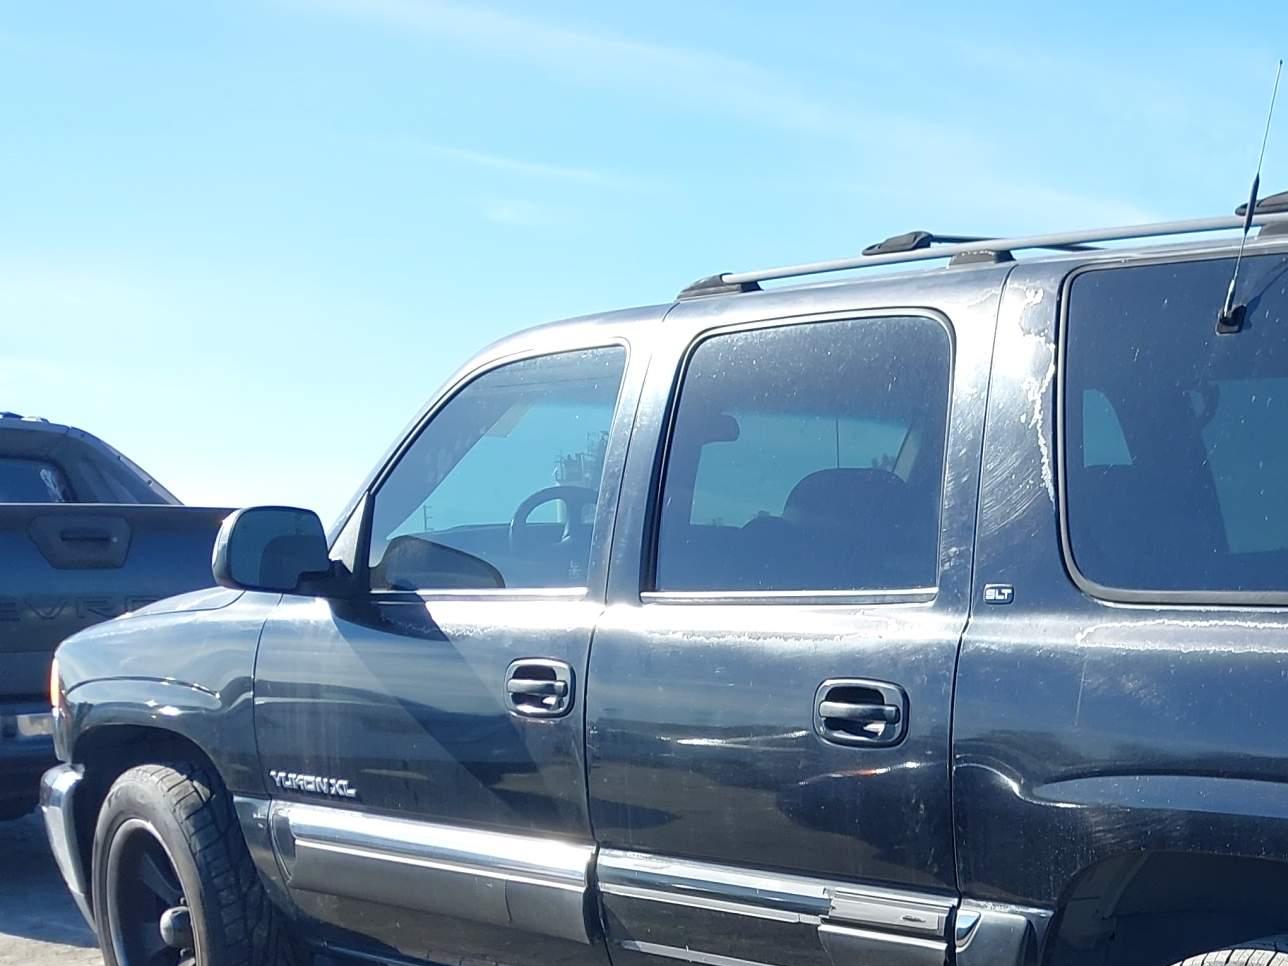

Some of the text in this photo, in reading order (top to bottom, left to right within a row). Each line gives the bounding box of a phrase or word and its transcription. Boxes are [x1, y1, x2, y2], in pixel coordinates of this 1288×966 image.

[985, 588, 1013, 600] SLT
[269, 770, 357, 798] YUKON XL
